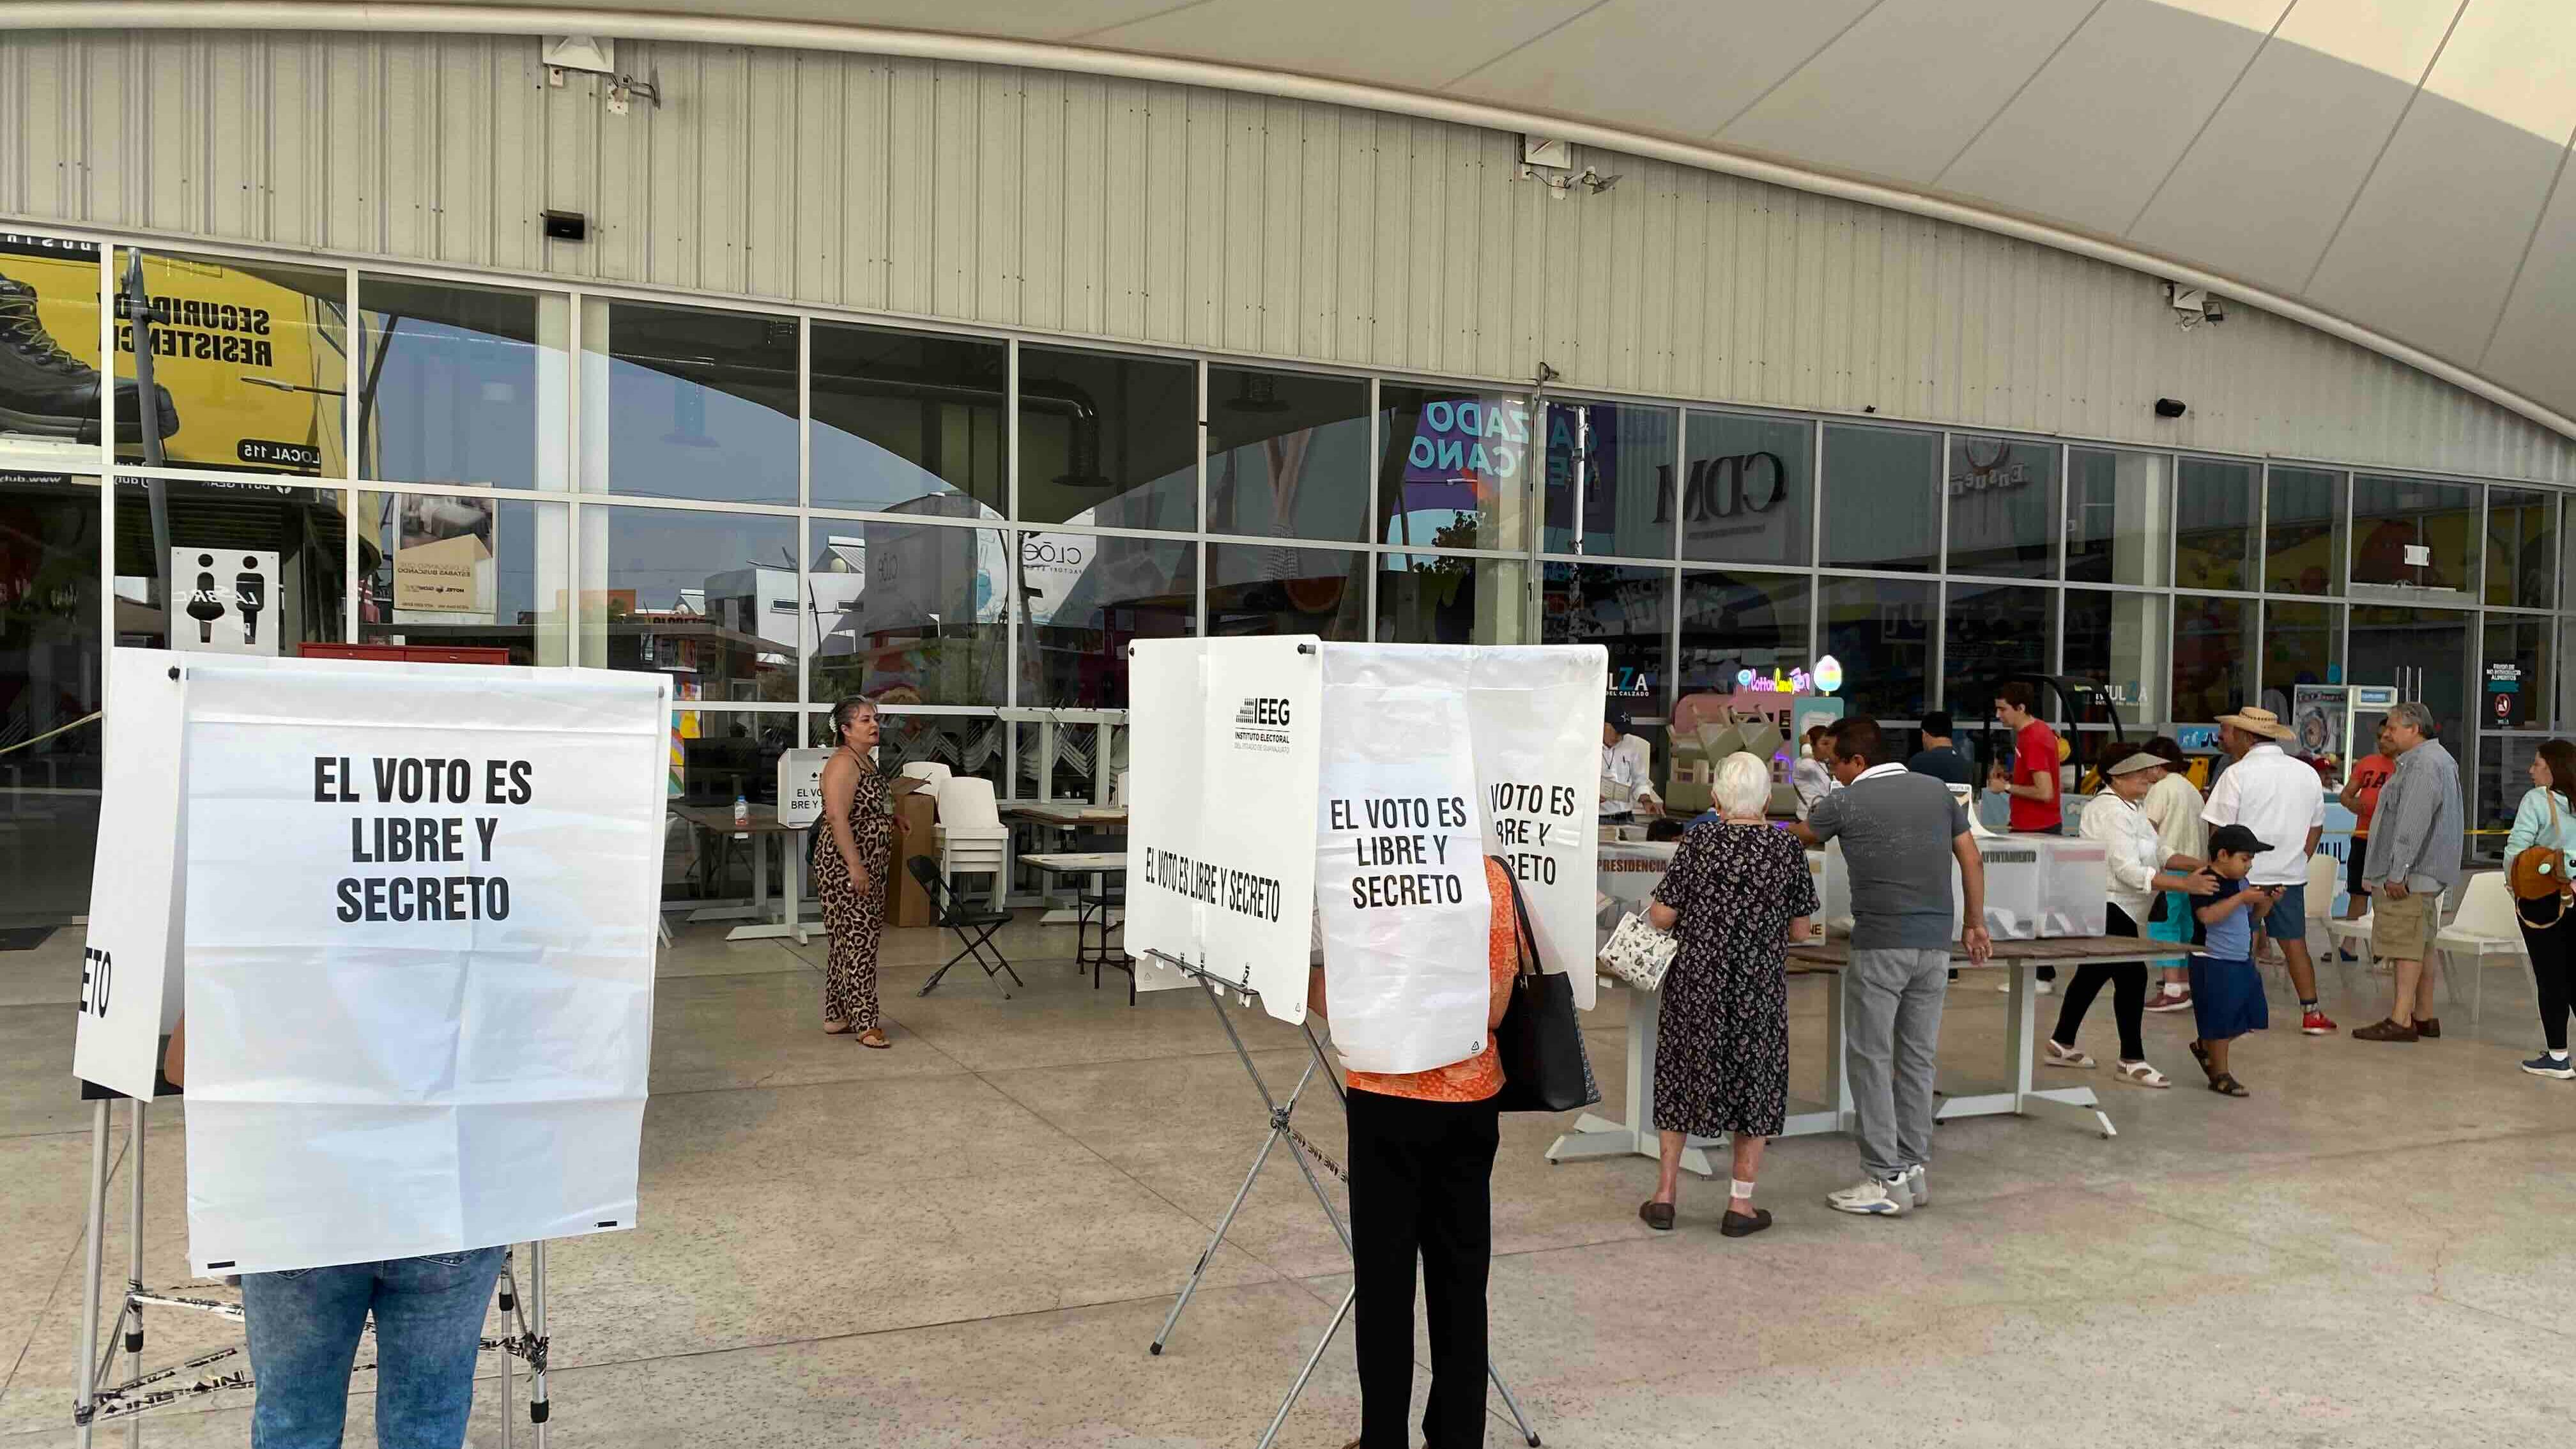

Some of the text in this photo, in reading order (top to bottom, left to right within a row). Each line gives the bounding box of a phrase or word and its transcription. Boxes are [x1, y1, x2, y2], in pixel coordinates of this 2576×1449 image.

[1254, 698, 1290, 726] IEEG
[1235, 732, 1290, 744] INSTITUTO ELECTORAL
[315, 756, 532, 804] EL VOTO ES
[797, 788, 808, 797] EL
[813, 800, 818, 809] Y
[1331, 797, 1467, 829] EL VOTO ES
[1491, 783, 1575, 816] VOTO ES
[352, 817, 498, 862] LIBRE Y
[1356, 834, 1448, 866] LIBRE Y
[1539, 822, 1552, 847] Y
[337, 877, 510, 923] SECRETO
[1146, 847, 1280, 923] EL VOTO ES LIBRE Y SECRETO
[1353, 874, 1462, 909] SECRETO
